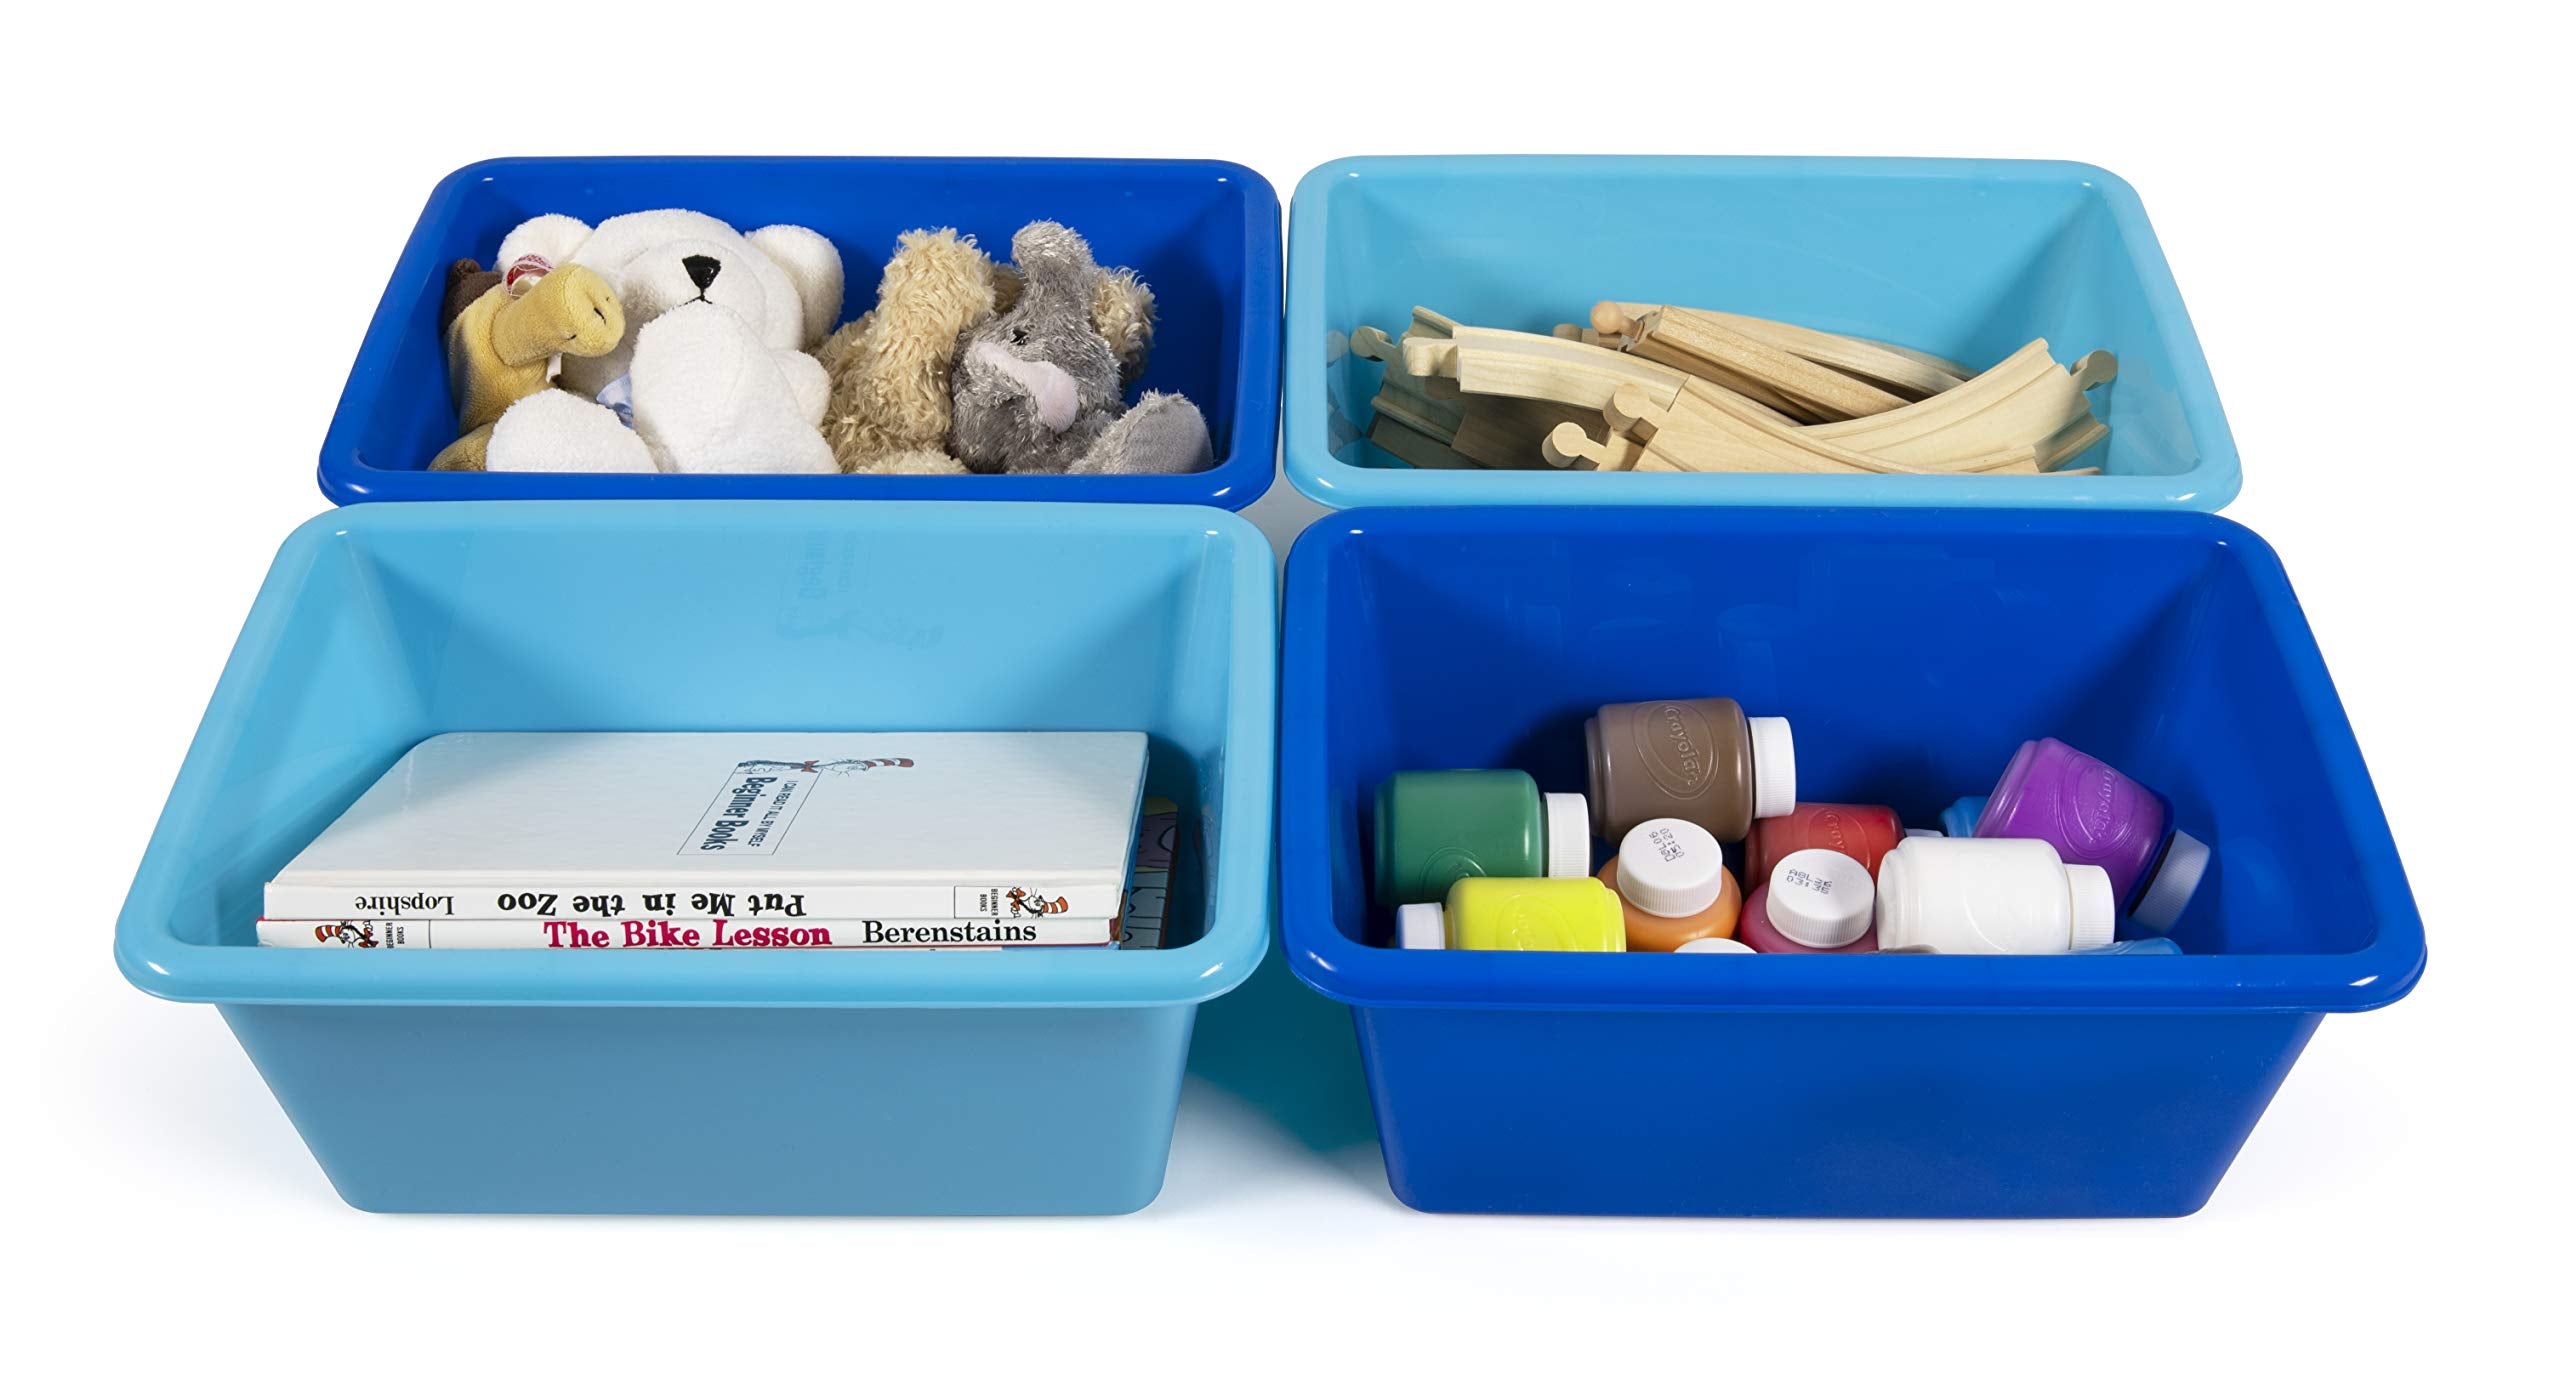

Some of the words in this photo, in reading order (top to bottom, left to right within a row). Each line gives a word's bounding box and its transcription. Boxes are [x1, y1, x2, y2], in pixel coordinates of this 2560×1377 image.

[1663, 706, 1698, 772] Crayola
[723, 777, 778, 818] Beginner
[700, 820, 749, 851] Books
[355, 892, 454, 916] Lopshire
[497, 892, 558, 917] Zoo
[572, 894, 626, 917] the
[642, 893, 677, 917] in
[691, 892, 736, 917] Me
[748, 893, 807, 917] Put
[979, 893, 988, 912] BOOKS
[990, 888, 999, 916] BEGINNER
[385, 922, 395, 949] BEGINNER
[396, 926, 405, 945] BOOKS
[543, 920, 610, 948] The
[620, 919, 700, 947] Bike
[712, 919, 833, 947] Lesson
[862, 919, 1037, 943] Berenstains
